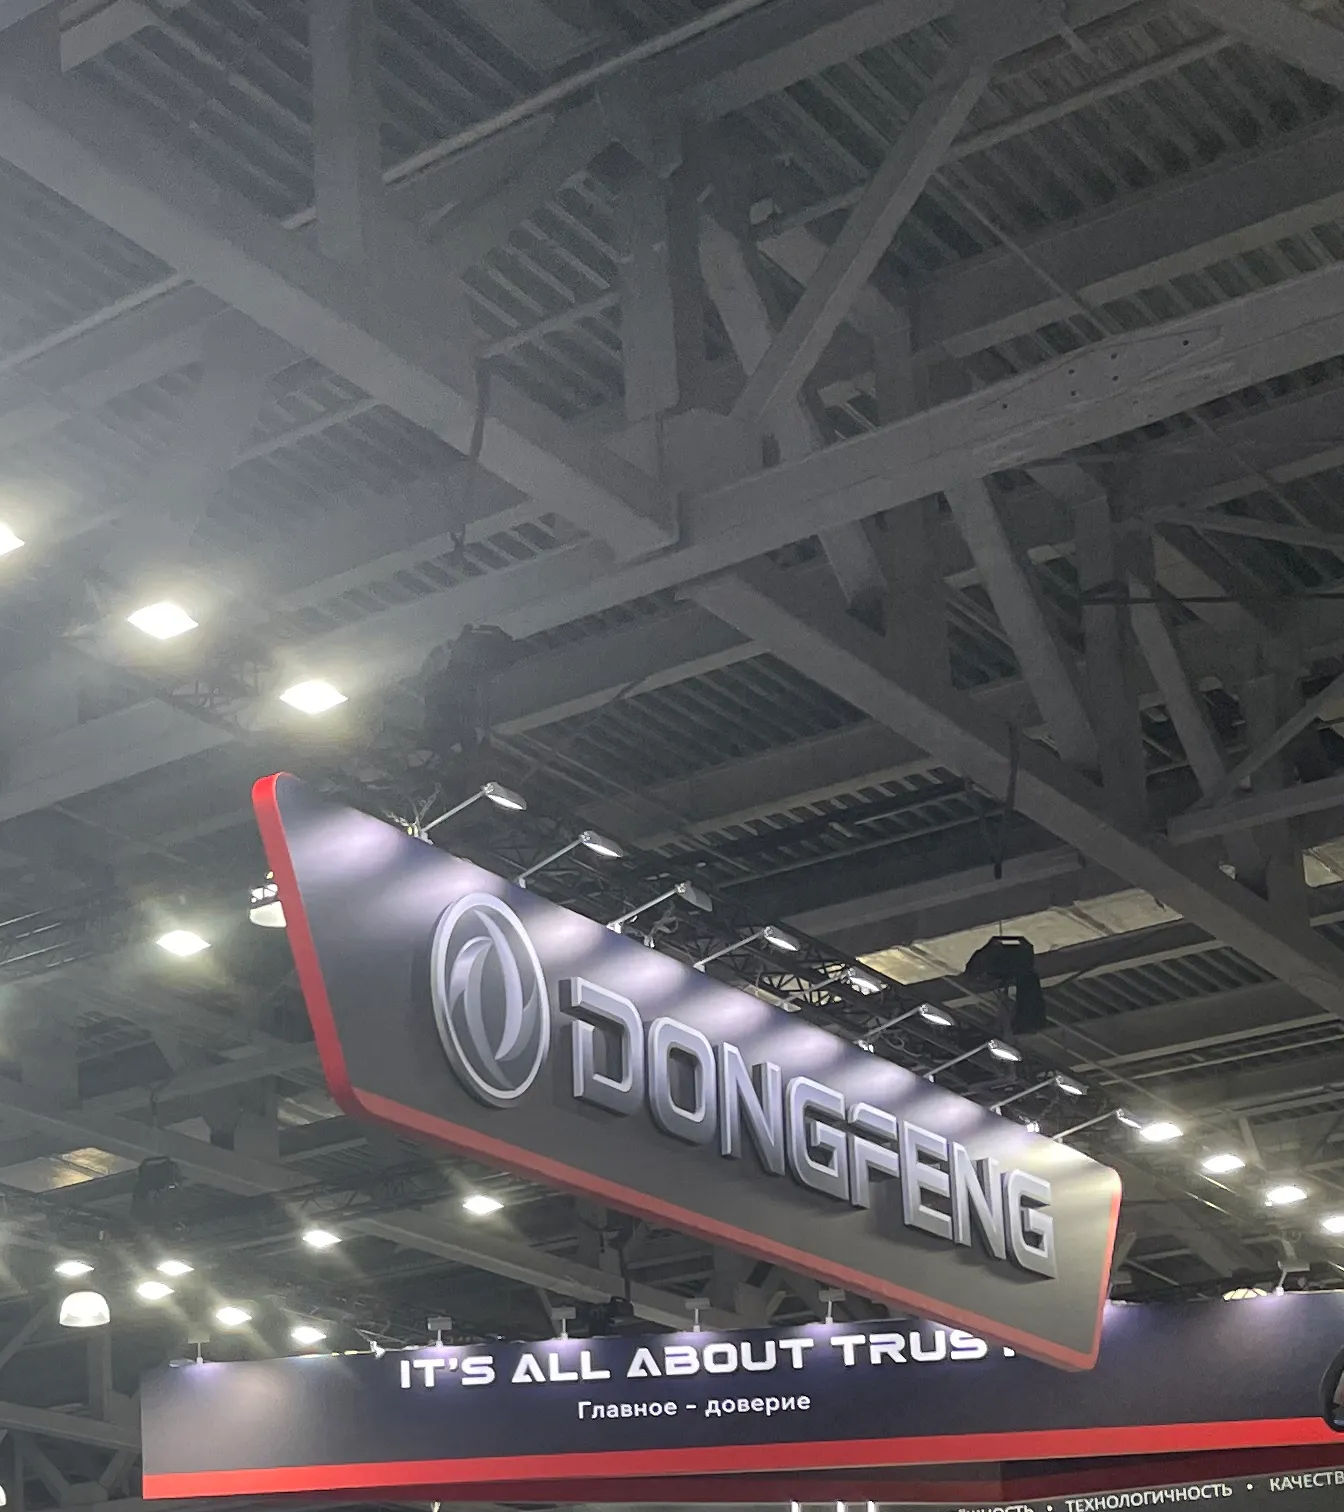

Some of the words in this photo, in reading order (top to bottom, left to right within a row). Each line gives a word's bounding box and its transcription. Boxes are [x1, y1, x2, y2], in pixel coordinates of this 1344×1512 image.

[559, 975, 1059, 1280] DONGFENG
[399, 1355, 496, 1389] IT'S
[510, 1350, 611, 1384] ALL
[626, 1337, 815, 1379] ABOUT
[830, 1329, 1016, 1368] TRUS
[577, 1400, 678, 1420] Главное
[704, 1394, 811, 1418] доверие
